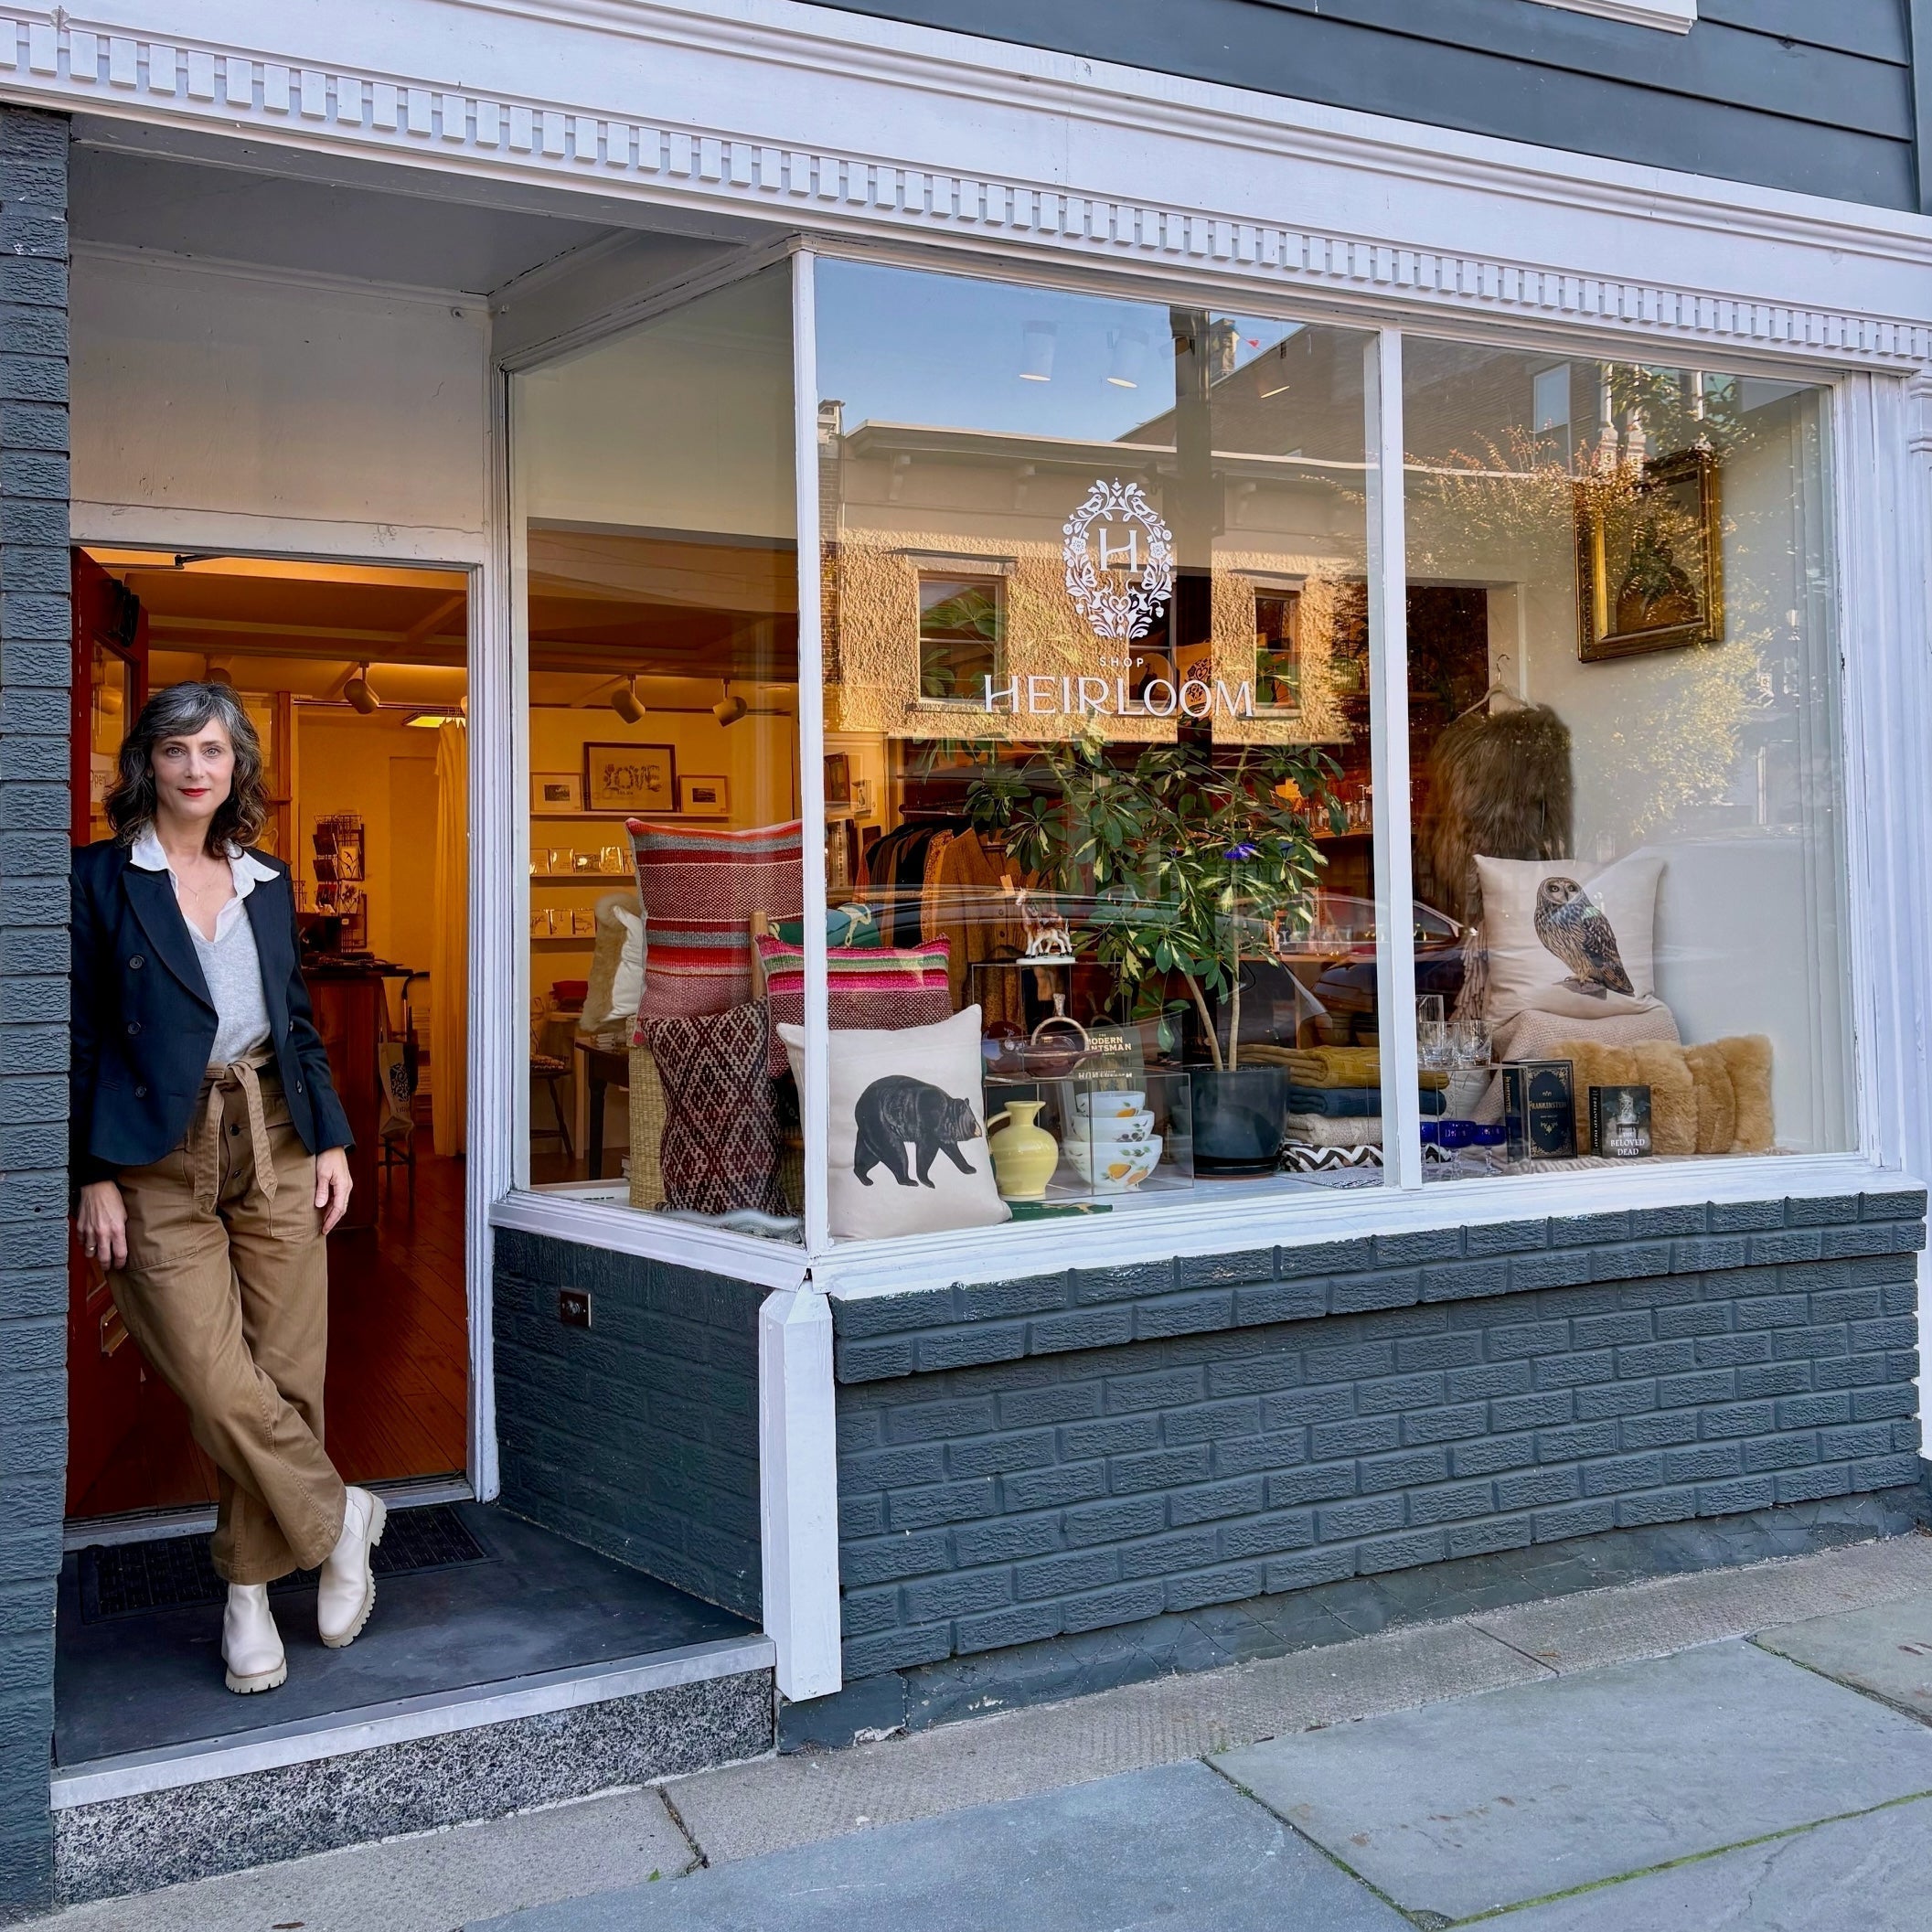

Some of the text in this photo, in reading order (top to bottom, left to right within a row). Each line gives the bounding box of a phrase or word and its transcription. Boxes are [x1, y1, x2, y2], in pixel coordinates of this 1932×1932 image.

[1099, 528, 1137, 572] H
[1099, 656, 1144, 668] SHOP
[984, 674, 1254, 718] HEIRLOOM
[1091, 1043, 1132, 1052] NTSMAN
[1610, 1138, 1645, 1147] BELOVED
[1617, 1147, 1639, 1156] DEAD
